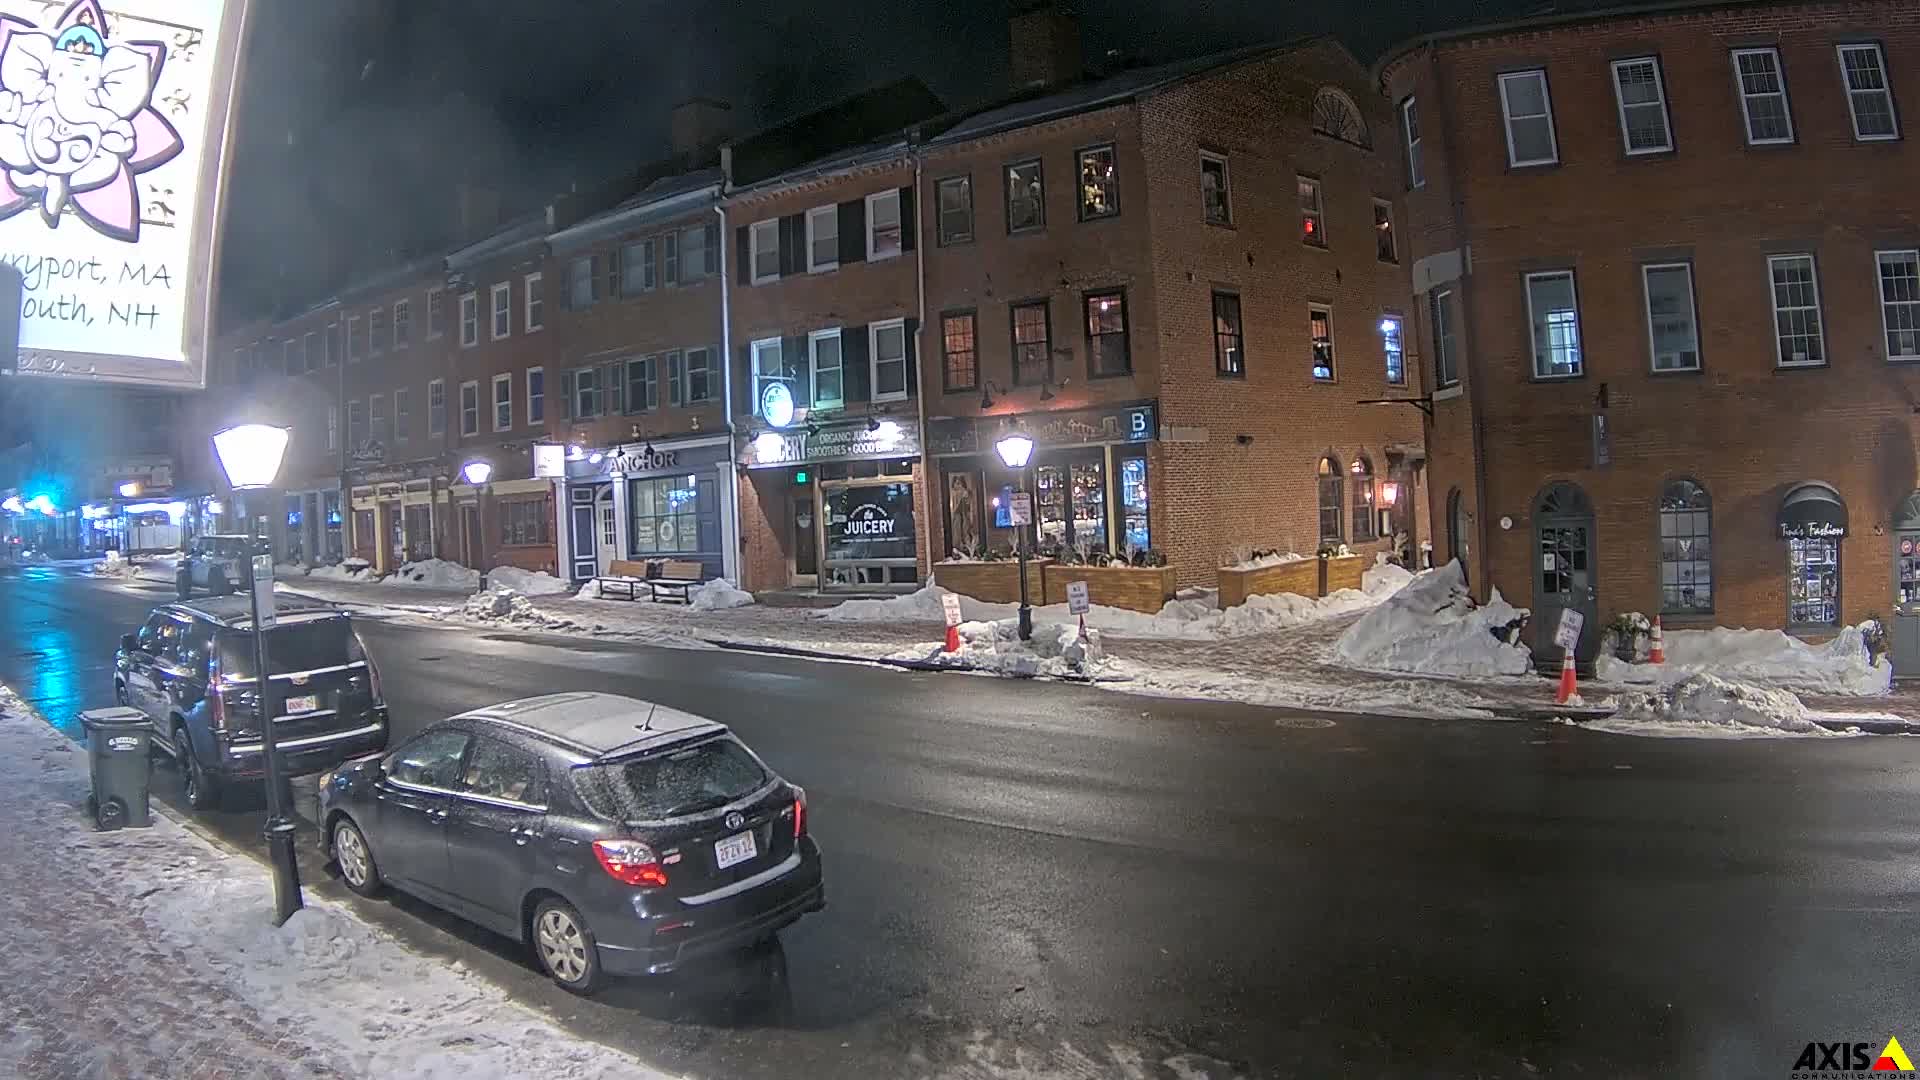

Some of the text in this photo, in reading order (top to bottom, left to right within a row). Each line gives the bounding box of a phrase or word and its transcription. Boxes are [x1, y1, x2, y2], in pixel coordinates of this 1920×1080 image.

[0, 253, 172, 291] ryport, MA
[108, 301, 160, 330] NH
[1131, 412, 1146, 431] B
[819, 431, 852, 444] ORGANIC
[807, 446, 847, 457] SMOOTHIES
[852, 441, 876, 453] GOOD
[609, 451, 679, 471] ANCHOR
[843, 519, 895, 535] JUICERY
